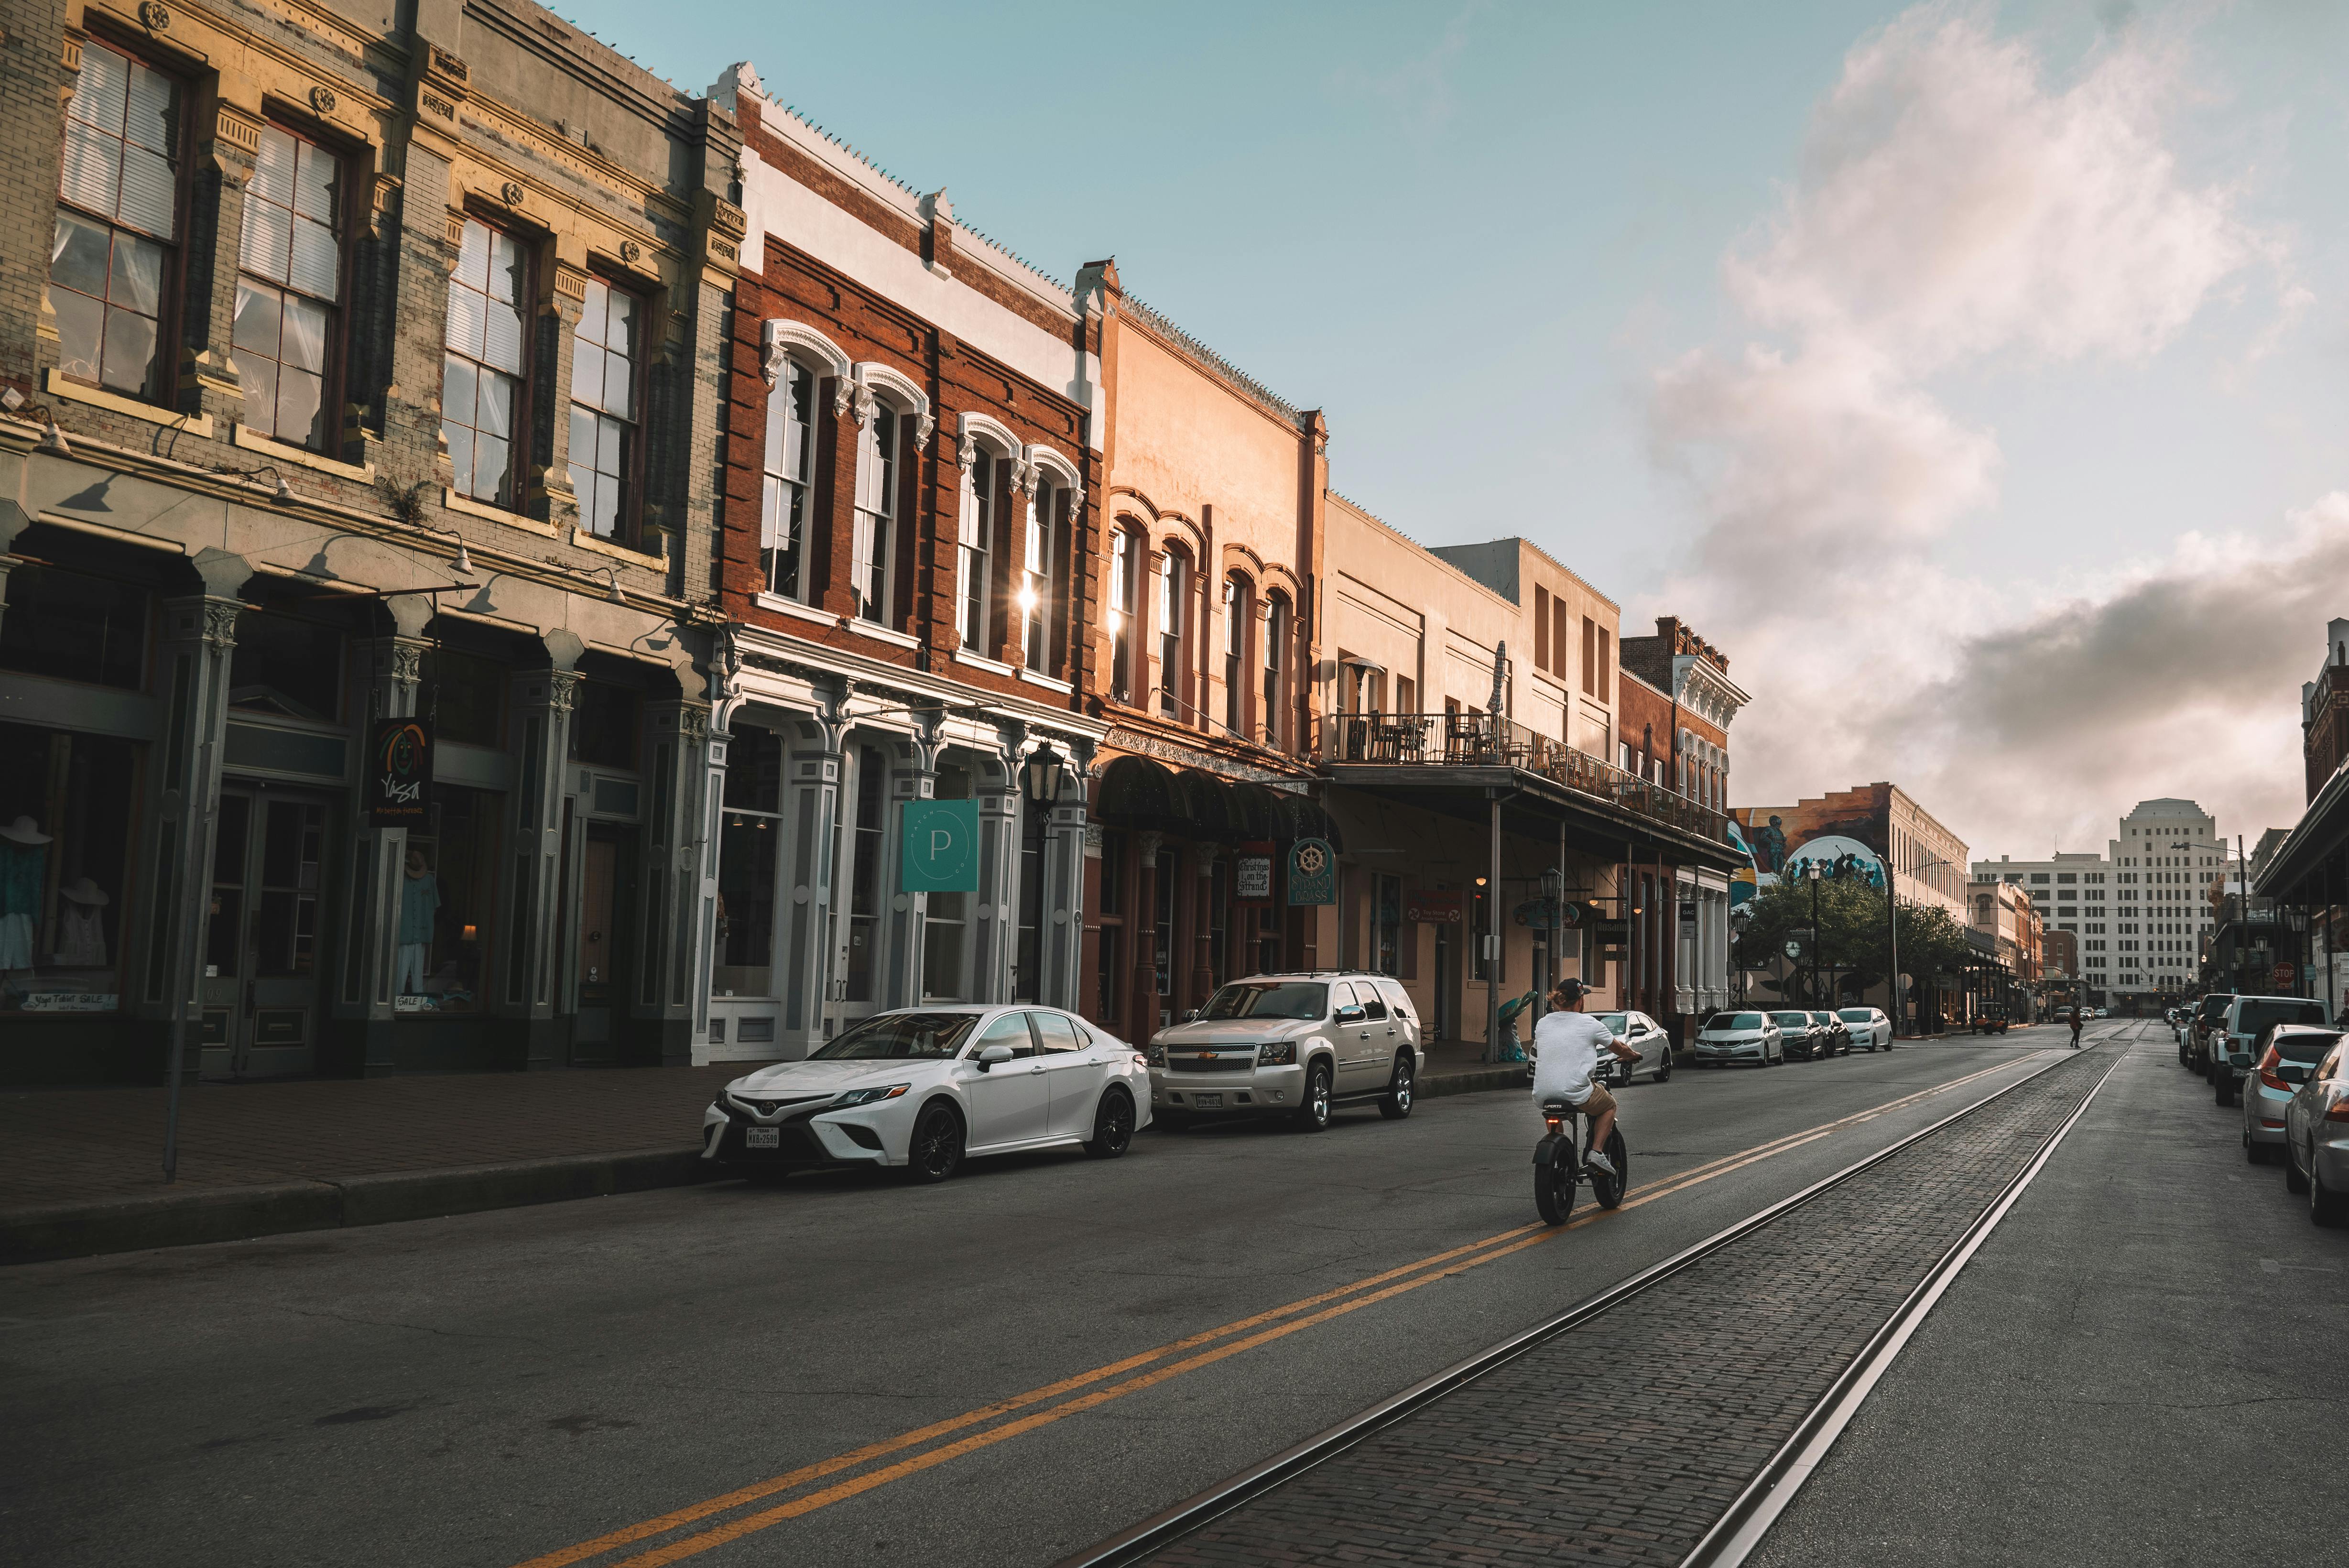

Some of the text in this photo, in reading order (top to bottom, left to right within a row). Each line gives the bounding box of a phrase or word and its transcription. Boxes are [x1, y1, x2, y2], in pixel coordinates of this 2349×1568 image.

[911, 811, 933, 838] PATCH
[930, 830, 951, 860] P
[956, 862, 965, 873] CO
[1239, 860, 1270, 871] Christmas
[1256, 871, 1269, 880] the
[1239, 879, 1267, 891] Strand
[1292, 874, 1331, 890] STRAND
[1296, 890, 1327, 903] BRASS
[1521, 902, 1540, 914] Surf
[1604, 952, 1627, 960] BEER
[2274, 969, 2295, 977] STOP
[80, 995, 104, 1003] SALE
[398, 997, 418, 1006] SALE
